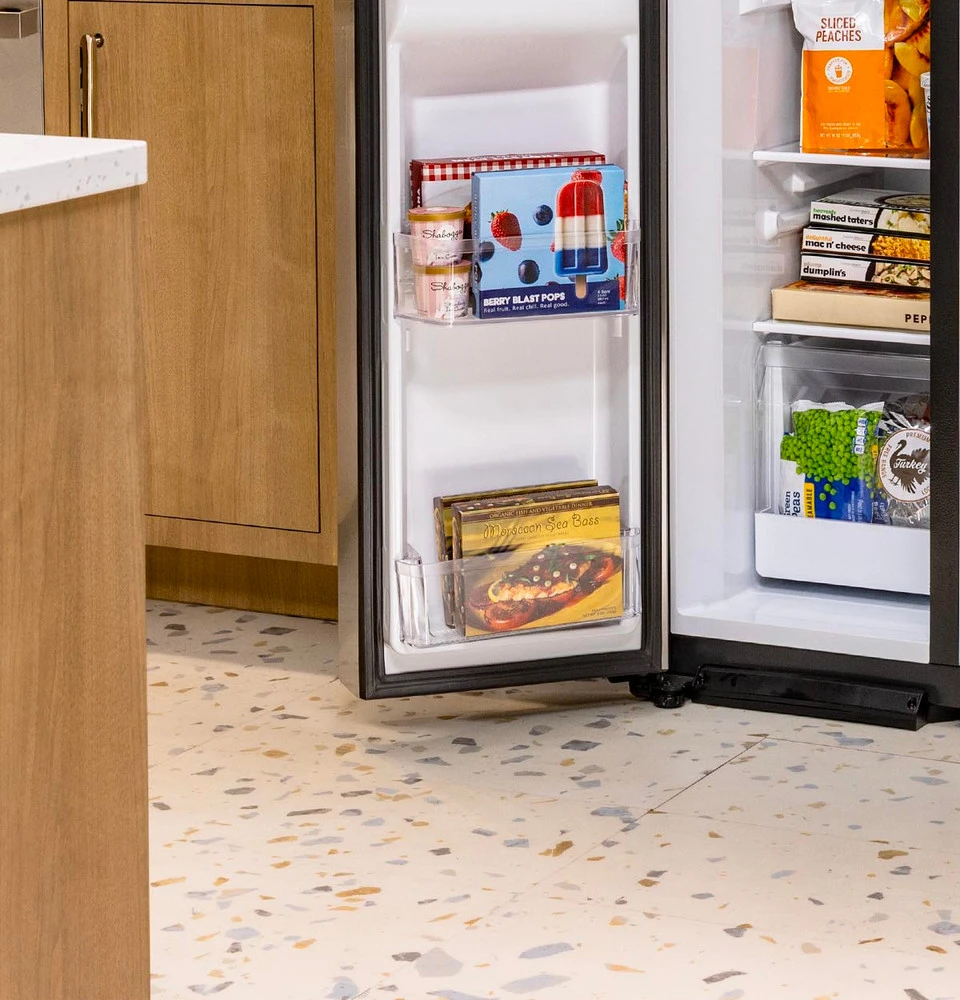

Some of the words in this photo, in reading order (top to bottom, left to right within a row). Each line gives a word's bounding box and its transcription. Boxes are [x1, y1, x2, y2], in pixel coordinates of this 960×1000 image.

[820, 17, 856, 29] SLICED
[815, 29, 862, 42] PEACHES
[812, 213, 846, 223] mashed
[847, 215, 873, 225] taters
[805, 240, 824, 248] mac
[836, 241, 866, 252] cheese
[803, 265, 847, 278] dumplin's
[483, 296, 511, 307] BERRY
[512, 294, 540, 304] BLAST
[541, 292, 566, 302] POPS
[904, 313, 930, 325] PEP
[893, 458, 928, 474] Turkey
[489, 510, 515, 518] ORGANIC
[571, 501, 593, 509] DINNER
[483, 522, 542, 539] Moroccan
[545, 516, 568, 532] Sea
[572, 513, 600, 528] Bass
